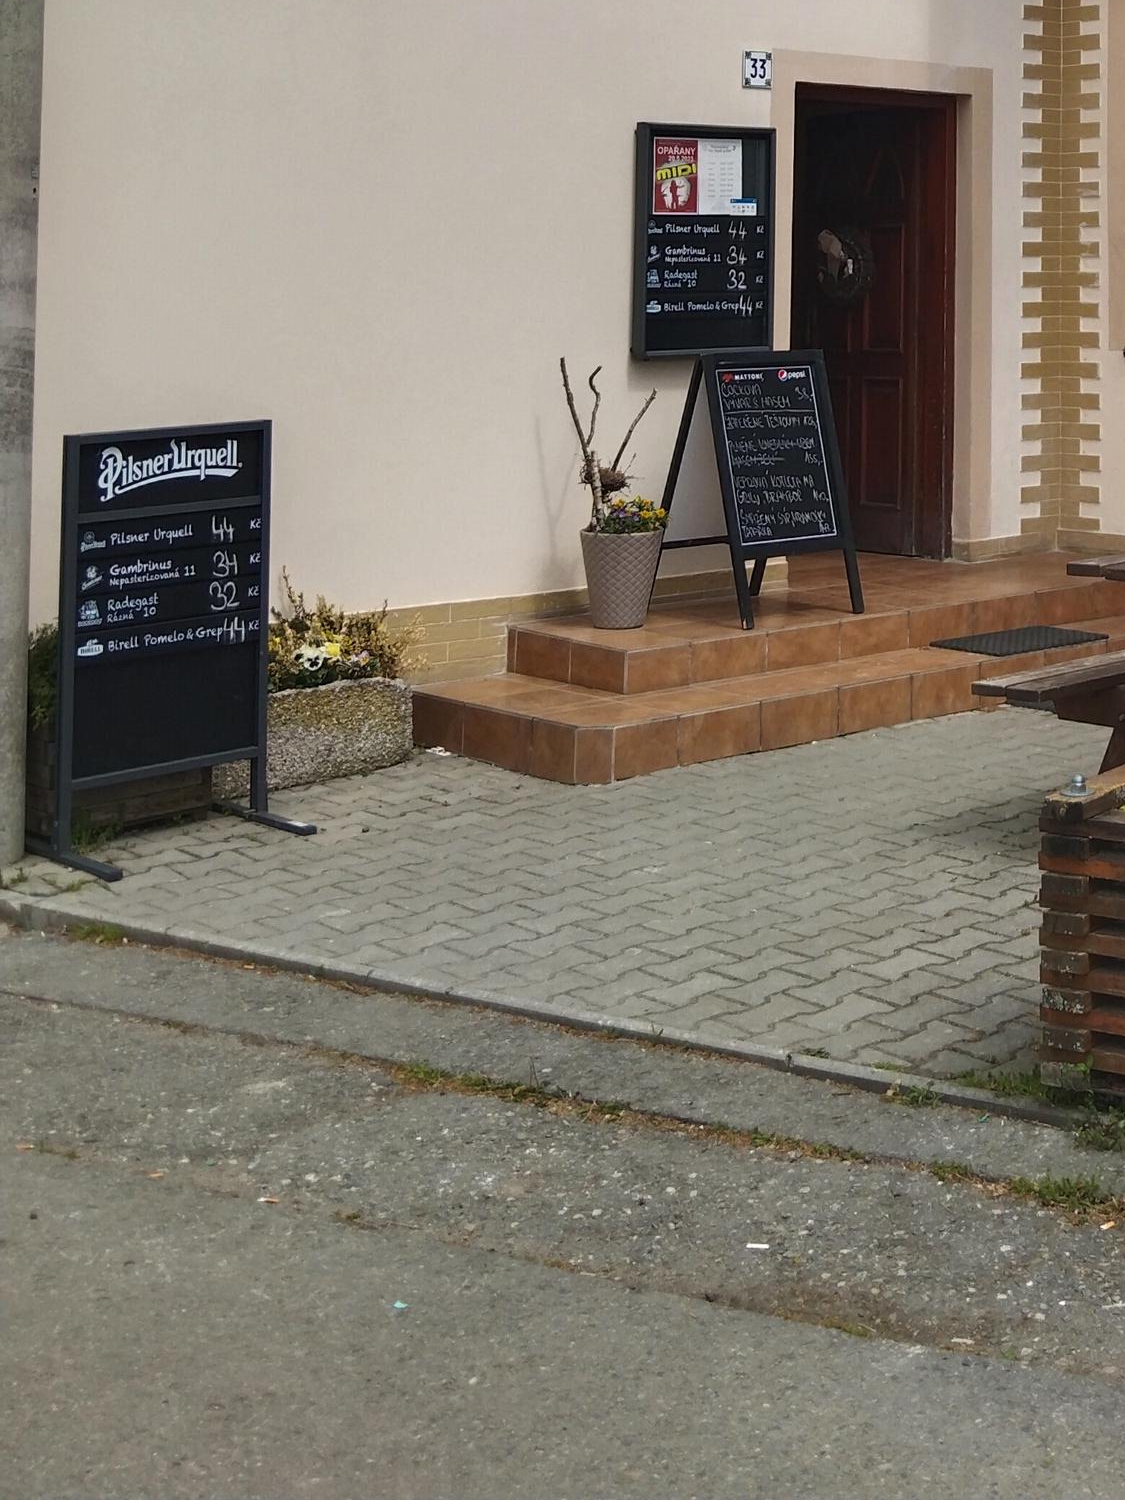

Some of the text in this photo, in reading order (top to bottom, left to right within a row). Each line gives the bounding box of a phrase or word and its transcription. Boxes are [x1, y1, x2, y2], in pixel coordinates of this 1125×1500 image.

[750, 58, 767, 79] 33
[665, 223, 691, 234] Pilsner
[693, 224, 720, 238] Urquell
[728, 220, 747, 240] 44
[665, 244, 706, 255] Gambrinus
[726, 245, 748, 266] 34
[664, 269, 698, 282] Radegast
[726, 268, 747, 289] 32
[687, 280, 697, 288] 10
[664, 302, 684, 311] Birell
[687, 301, 714, 311] Pomelo
[721, 301, 740, 315] Grep
[739, 294, 753, 317] 44
[788, 370, 806, 379] pepsi
[110, 533, 149, 546] Pilsner
[154, 524, 193, 544] Urquell
[212, 515, 234, 543] 44
[250, 518, 261, 529] Kč
[110, 550, 261, 577] Gambrinus 34 Kč
[110, 567, 180, 589] Nepasterizovaná
[184, 565, 196, 576] 11
[107, 581, 260, 611] Radegast 32 Kč
[107, 611, 134, 623] Rázná
[143, 607, 156, 617] 10
[108, 636, 139, 652] Birell
[144, 632, 184, 647] Pomelo
[196, 626, 223, 642] Grep
[223, 616, 245, 643] 44
[248, 619, 260, 631] Kč
